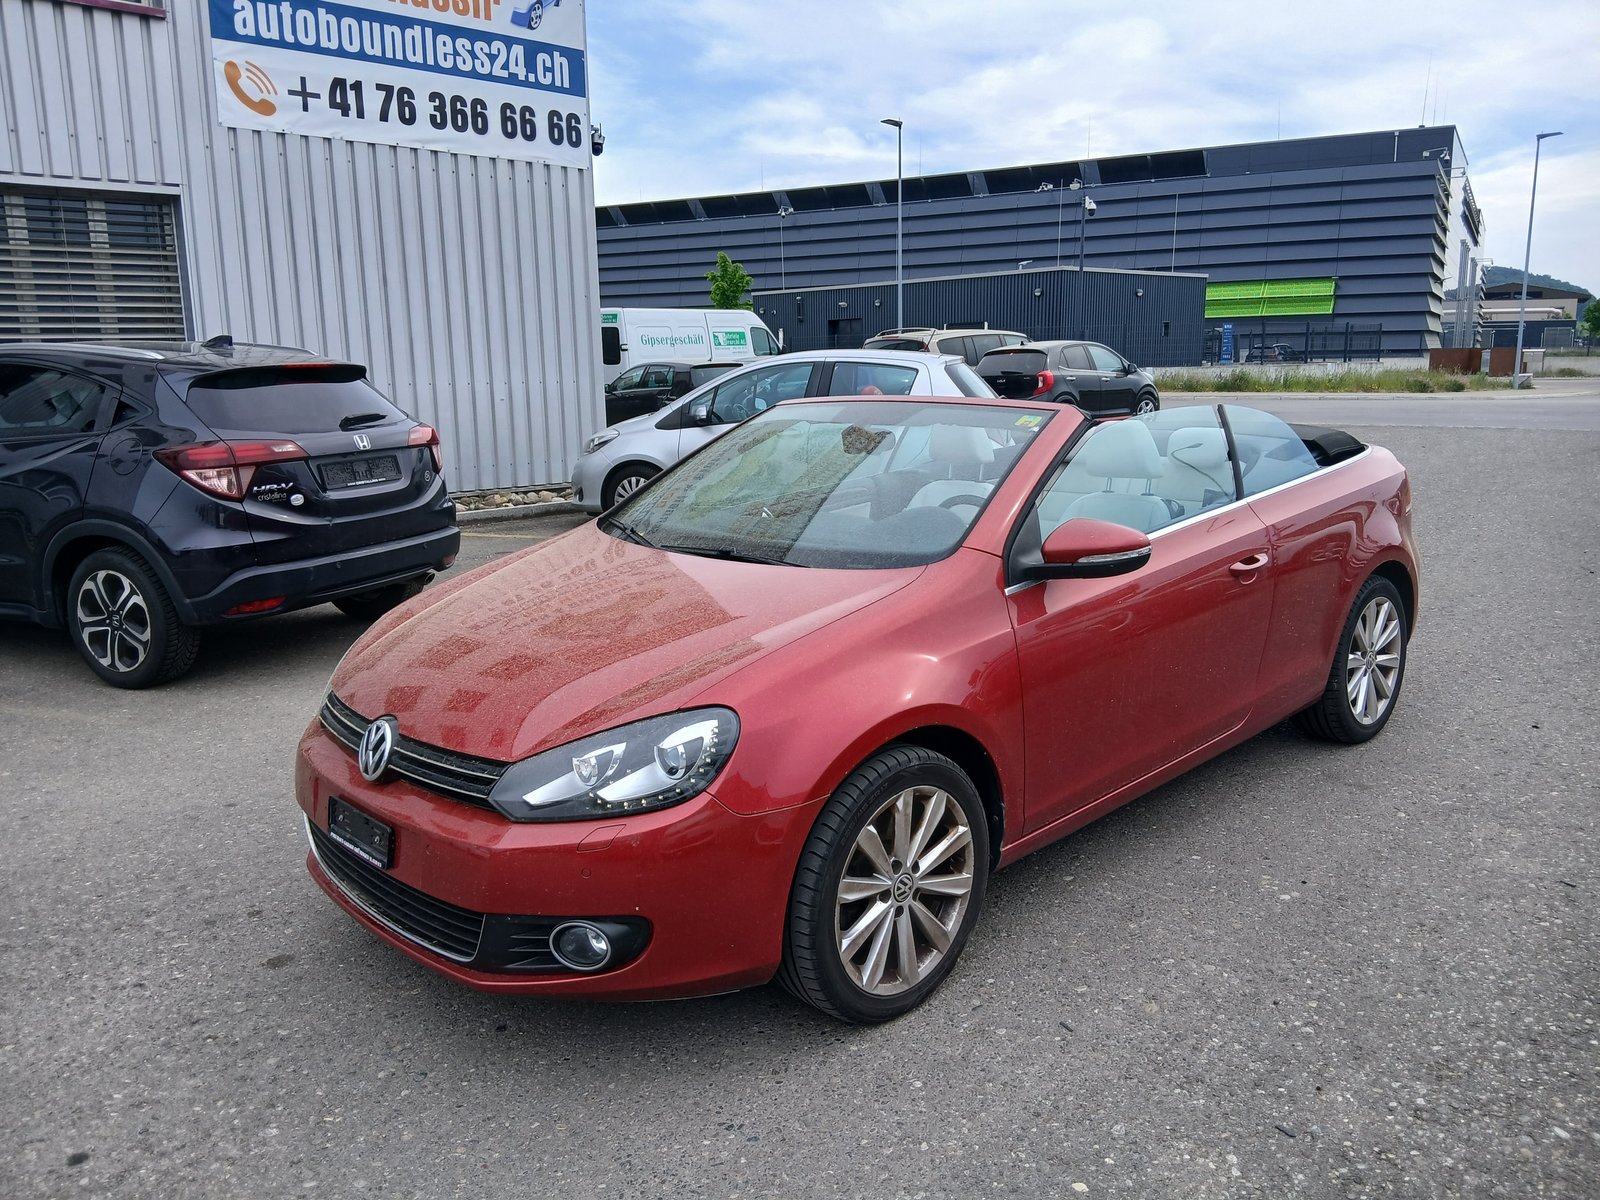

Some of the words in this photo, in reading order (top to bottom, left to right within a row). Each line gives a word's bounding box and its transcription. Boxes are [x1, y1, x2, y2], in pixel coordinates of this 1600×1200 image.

[233, 0, 570, 89] autoboundless24.ch
[375, 83, 417, 126] 76
[429, 91, 489, 136] 366
[500, 102, 537, 142] 66
[547, 110, 582, 149] 66
[640, 334, 704, 347] Gipsergeschäft
[253, 482, 294, 493] HR-V
